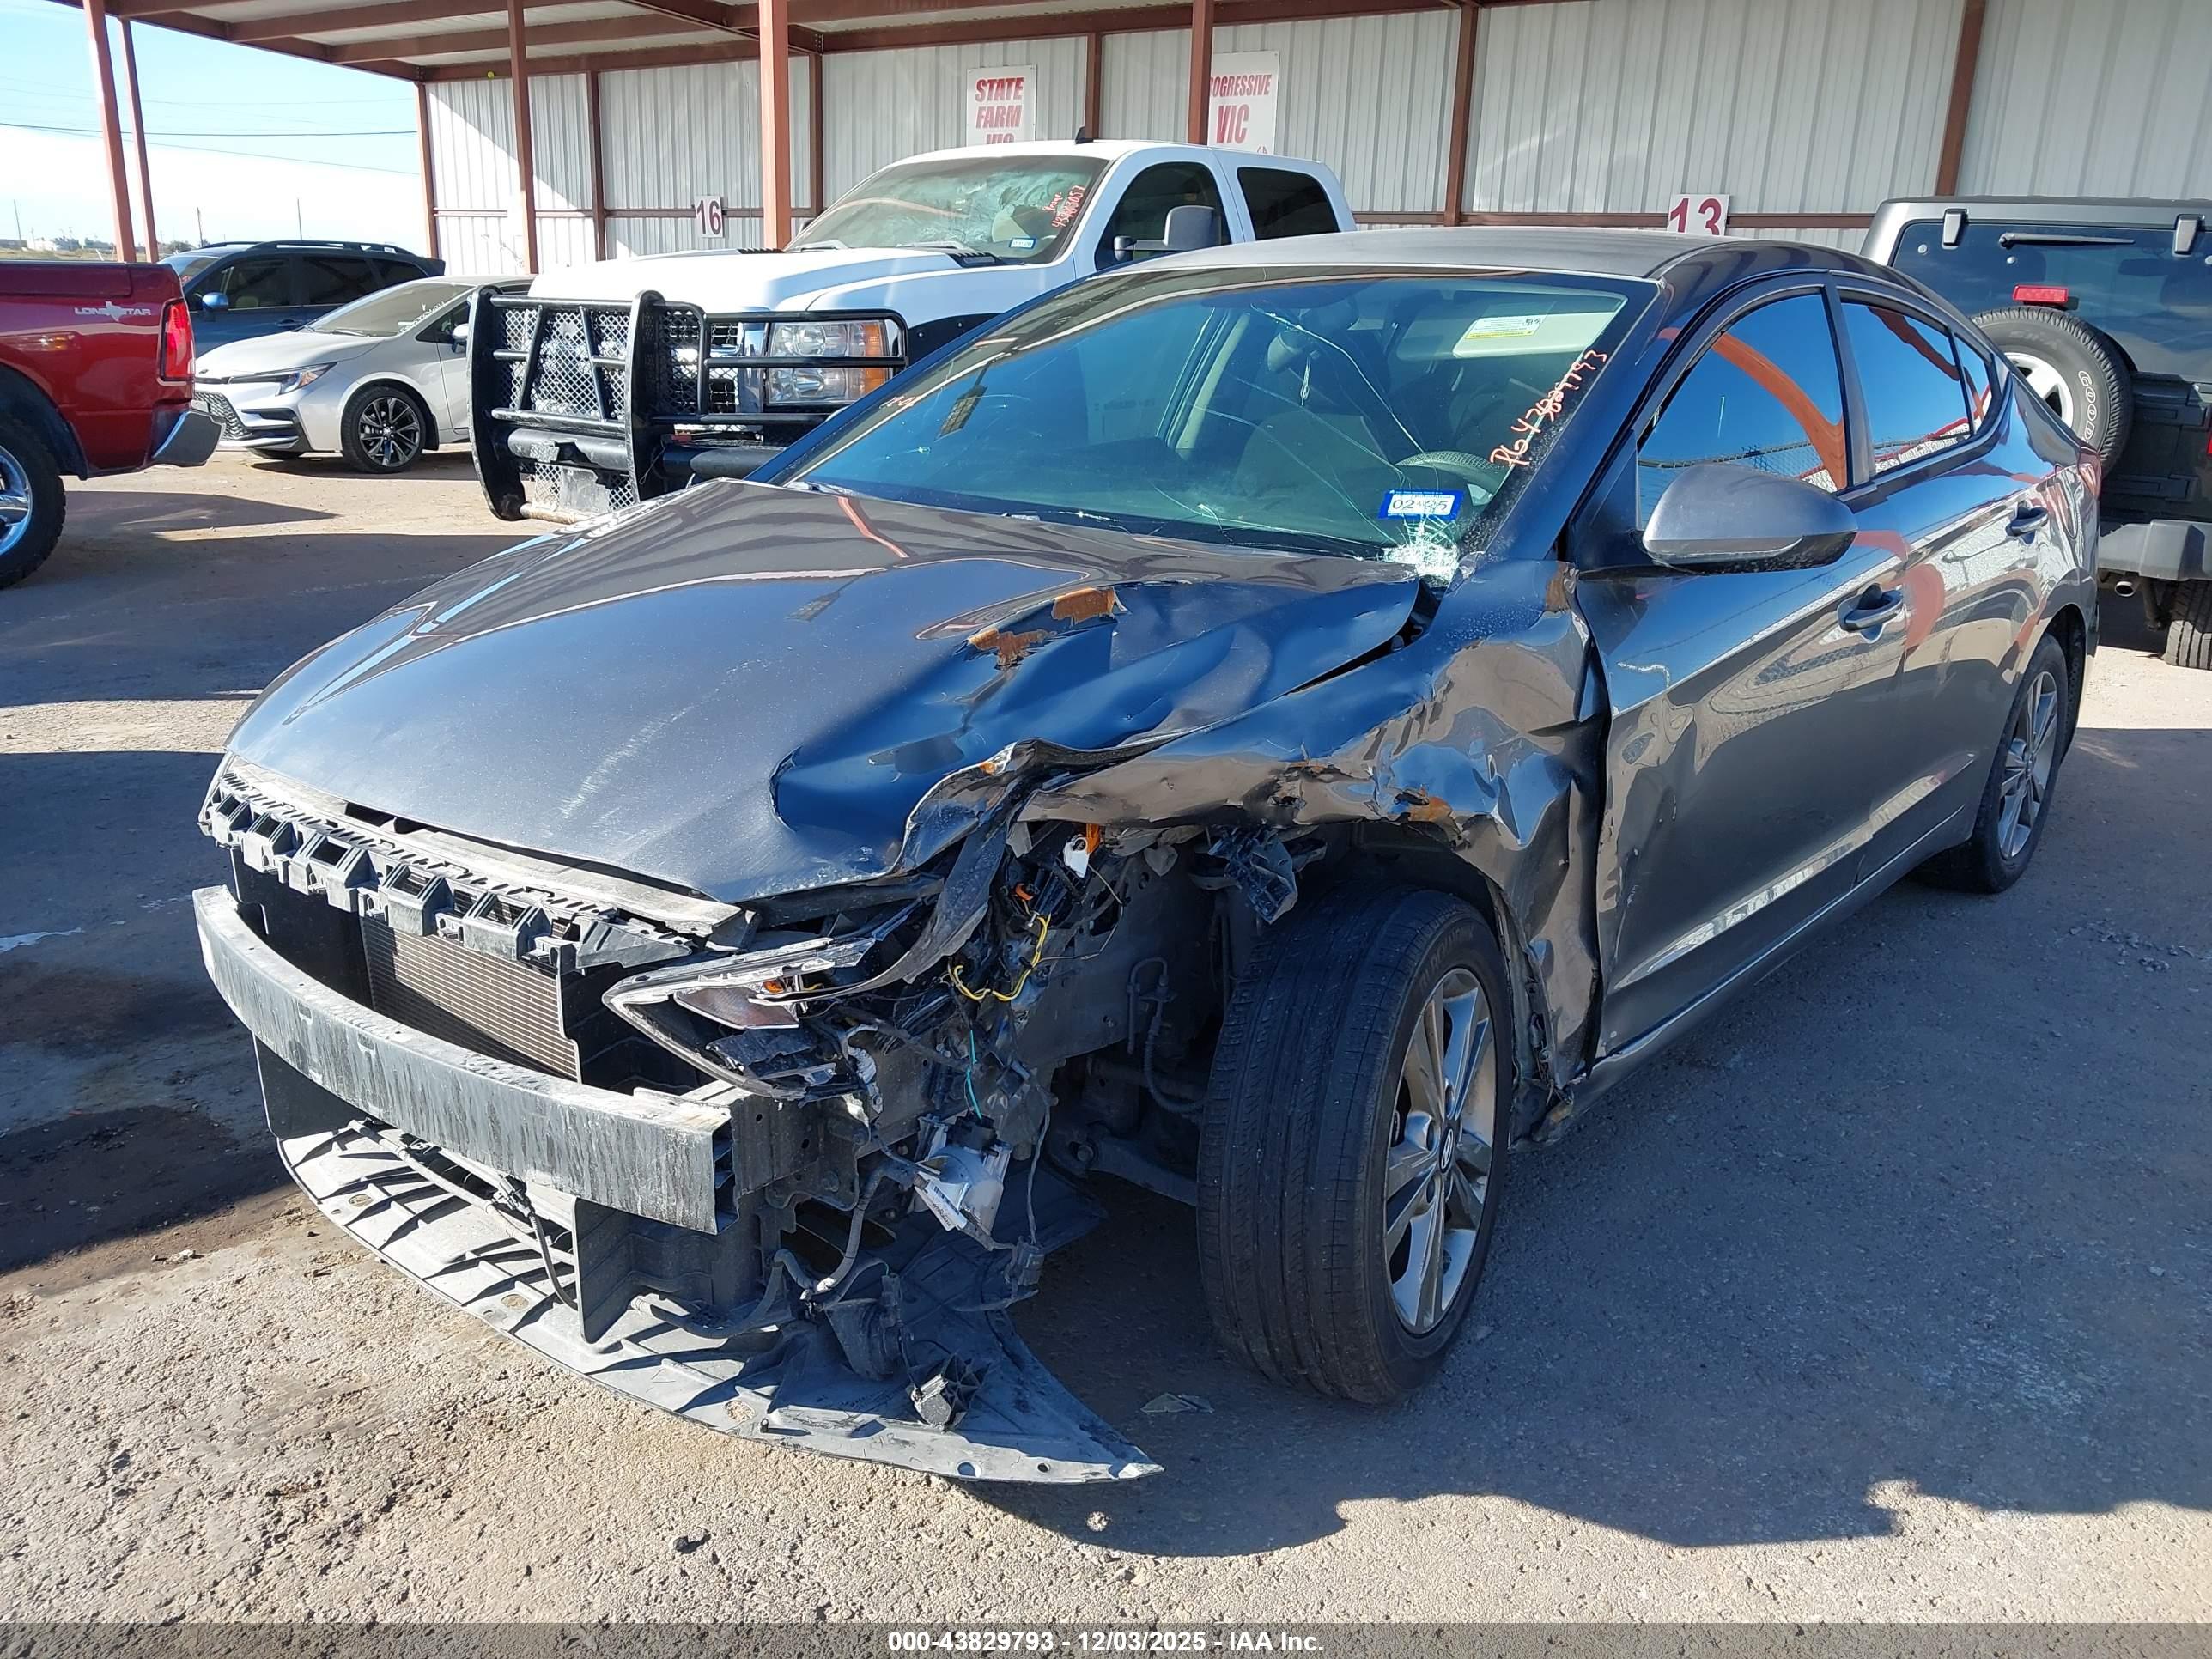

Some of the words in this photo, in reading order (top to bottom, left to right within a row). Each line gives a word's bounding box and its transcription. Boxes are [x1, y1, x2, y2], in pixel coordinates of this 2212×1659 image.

[975, 76, 1025, 102] STATE
[975, 105, 1023, 129] FARM
[1217, 104, 1249, 144] VIC
[696, 199, 721, 235] 16
[1669, 198, 1722, 236] 13
